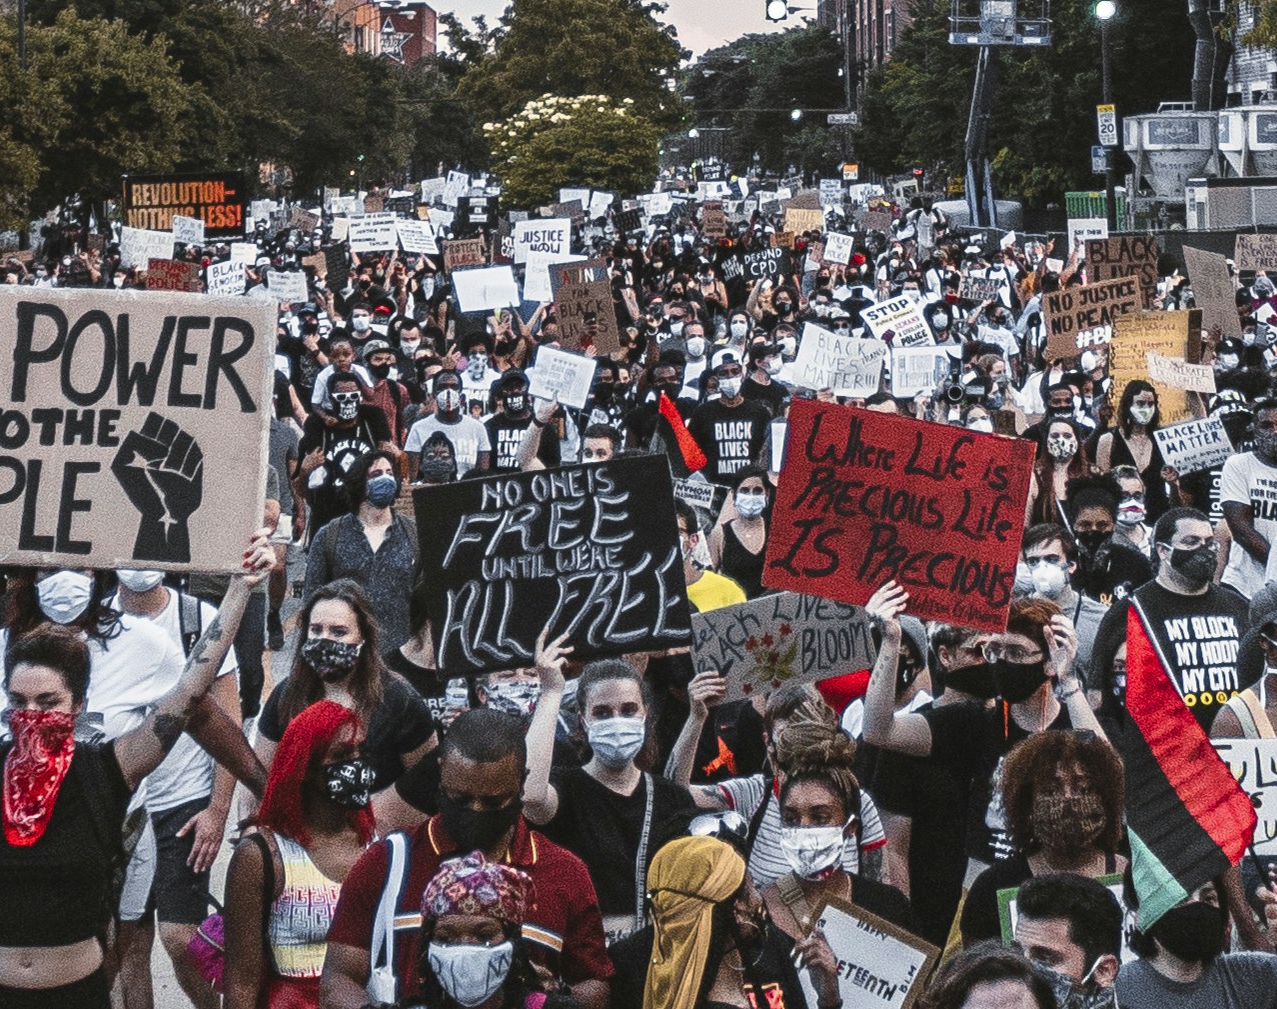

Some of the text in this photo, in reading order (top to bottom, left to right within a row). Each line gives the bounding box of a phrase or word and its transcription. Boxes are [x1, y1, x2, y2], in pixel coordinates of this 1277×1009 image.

[1100, 124, 1114, 133] 20
[200, 204, 242, 228] LESS!
[519, 230, 565, 243] JUSTICE
[529, 242, 561, 254] NOW
[744, 247, 783, 265] DEFUND
[1089, 238, 1158, 263] BLACK
[212, 262, 245, 278] BLACK
[750, 259, 777, 276] CPD
[561, 300, 603, 318] BLACK
[1048, 281, 1135, 313] NO JUSTICE
[866, 298, 909, 321] STOP
[1051, 301, 1135, 335] NO PEACE
[817, 333, 867, 356] BLACK
[901, 330, 928, 345] POLICE
[11, 301, 257, 413] POWER
[814, 350, 859, 374] LIVES
[27, 407, 122, 448] THE
[714, 421, 752, 441] BLACK
[1158, 425, 1196, 442] BLACK
[719, 440, 750, 459] LIVES
[805, 410, 1009, 491] Where Life is
[1166, 430, 1222, 455] MATTER
[481, 466, 616, 511] NO ONE IS
[1250, 488, 1265, 498] FOR
[791, 466, 1014, 542] PRECIOUS Life
[441, 493, 634, 569] FREE
[482, 541, 624, 581] UNTIL WE'RE
[769, 517, 1015, 608] IS PRECIOUS
[437, 545, 691, 669] ALL FREE
[772, 592, 857, 623] LIVES
[1164, 615, 1238, 642] MY BLOCK
[801, 621, 870, 673] BLOOM
[1175, 642, 1201, 665] MY
[1181, 665, 1239, 692] MY CITY
[856, 920, 888, 941] HAPPY
